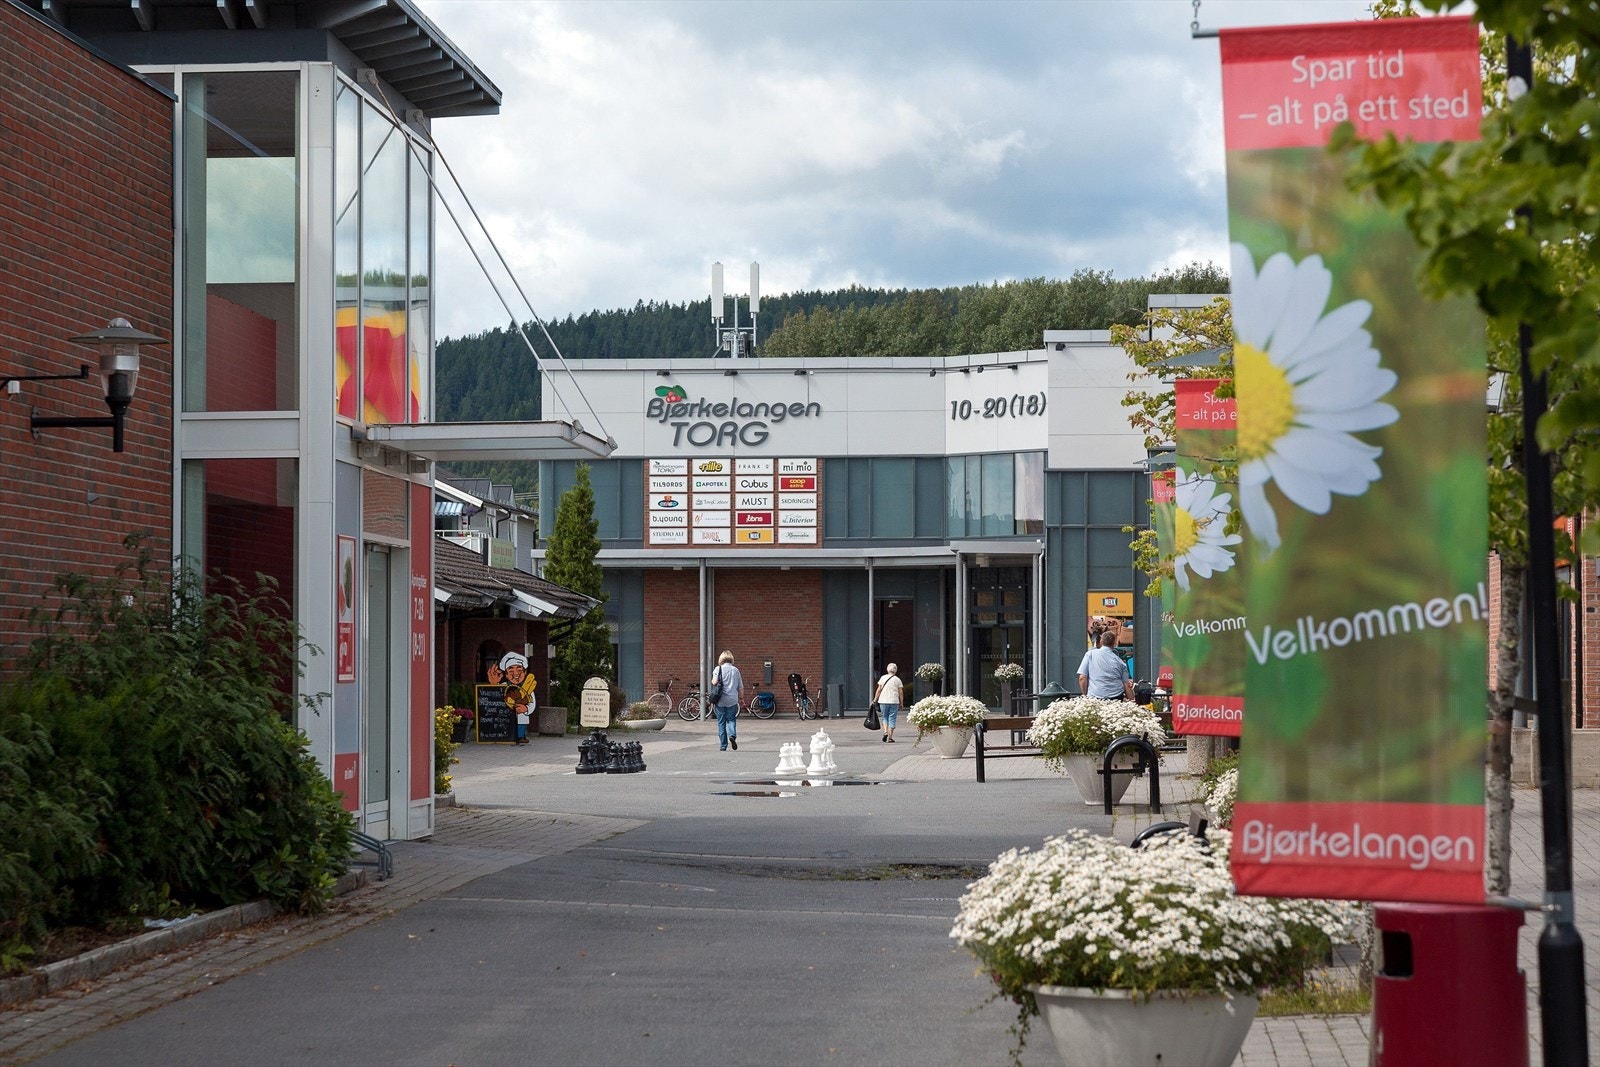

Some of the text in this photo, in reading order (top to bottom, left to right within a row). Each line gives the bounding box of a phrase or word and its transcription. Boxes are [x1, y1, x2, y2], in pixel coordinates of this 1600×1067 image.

[1291, 49, 1405, 89] Spar tid
[1266, 96, 1304, 127] alt
[1312, 93, 1349, 130] på
[1358, 95, 1400, 122] ett
[1408, 88, 1469, 121] sted
[646, 397, 821, 424] Bjørkelangen
[950, 391, 1047, 421] 10-20(18)
[1193, 408, 1208, 420] alt
[1211, 408, 1227, 423] på
[670, 421, 770, 447] TORG
[699, 461, 724, 473] nille
[782, 461, 812, 472] mi mio
[740, 479, 769, 489] Cubus
[741, 498, 768, 506] MUST
[1244, 581, 1489, 666] Velkommen!
[1241, 819, 1476, 871] Bjørkelangen
